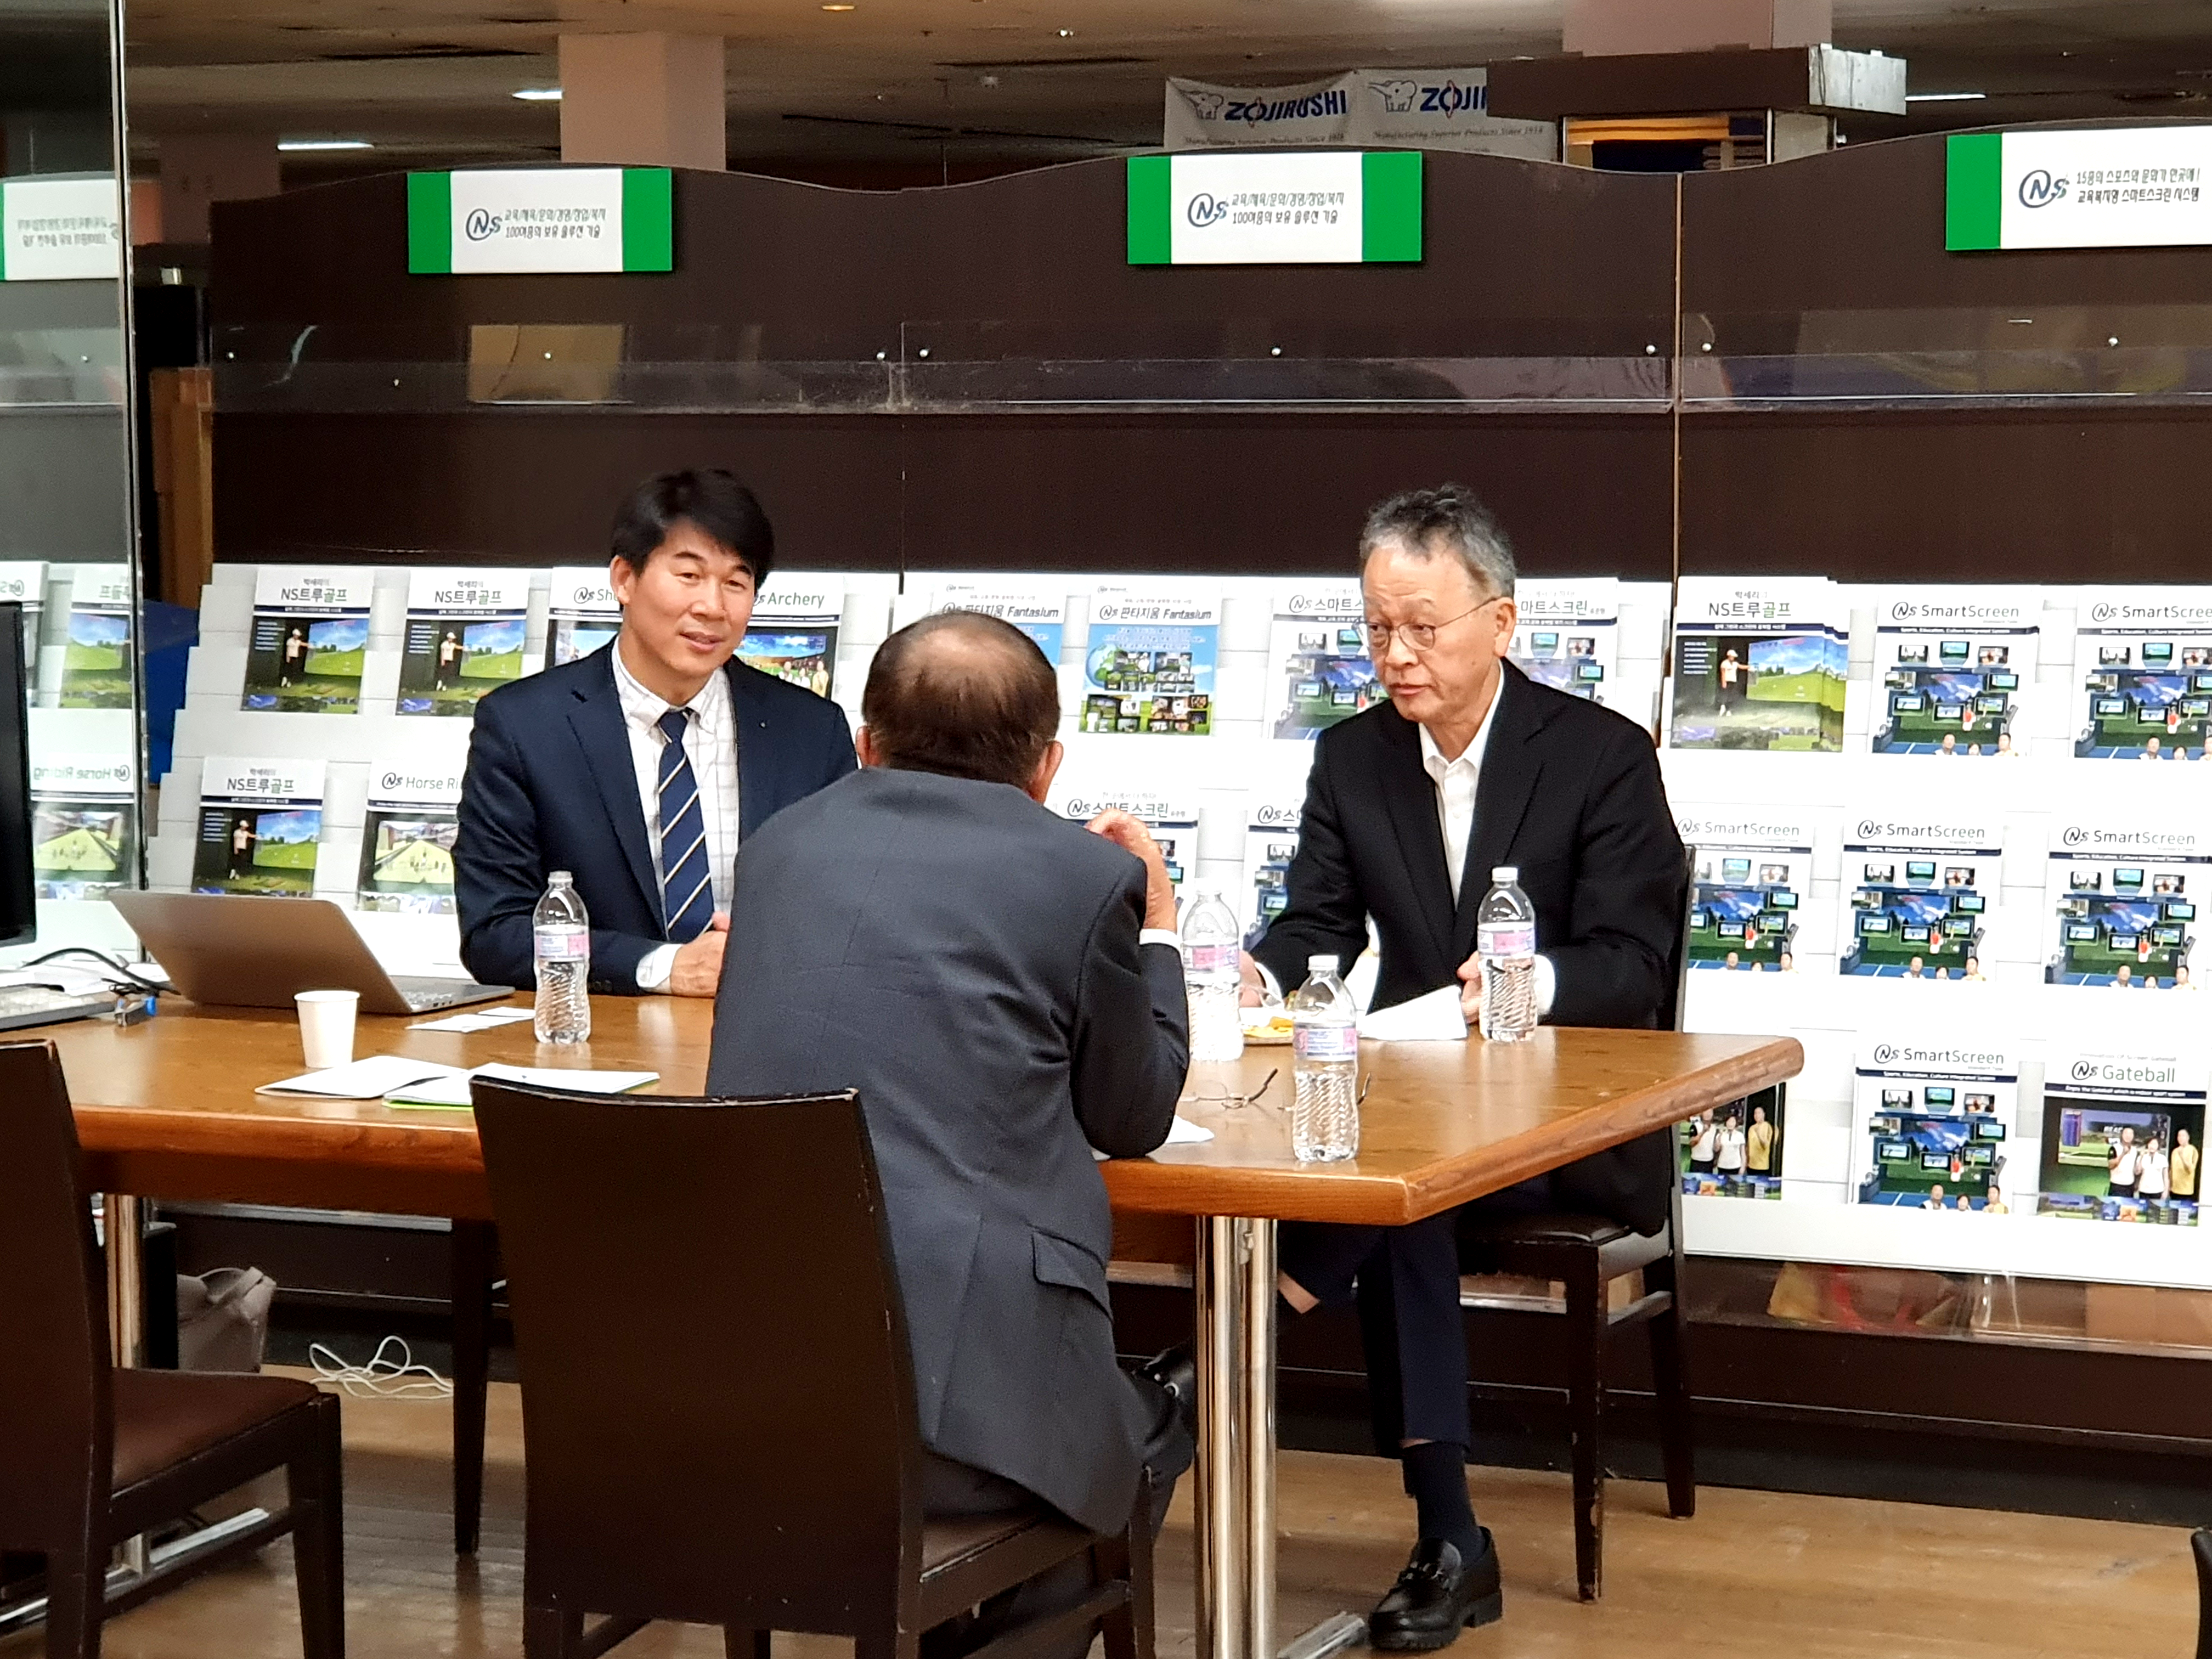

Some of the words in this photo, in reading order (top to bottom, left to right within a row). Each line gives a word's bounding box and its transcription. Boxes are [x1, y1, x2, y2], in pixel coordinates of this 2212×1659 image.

[1224, 90, 1347, 121] ZOJIRUSHI
[1420, 86, 1487, 112] ZOJI
[2121, 187, 2172, 204] 스마트스크린
[281, 588, 348, 603] NS트루골프
[435, 590, 502, 606] NS트루골프
[767, 592, 825, 610] Archery
[1314, 597, 1364, 612] 스마트스
[1708, 601, 1792, 619] NS트루골프
[1922, 605, 2019, 618] SmartScreen
[2122, 606, 2212, 618] SmartScree
[227, 777, 295, 794] NS트루골프
[405, 776, 444, 790] Horse
[1705, 821, 1800, 837] SmartScreen
[1887, 823, 1985, 839] SmartScreen
[2094, 830, 2196, 845] SmartScreen
[1904, 1048, 2005, 1065] SmartScreen
[2102, 1064, 2175, 1084] Gateball
